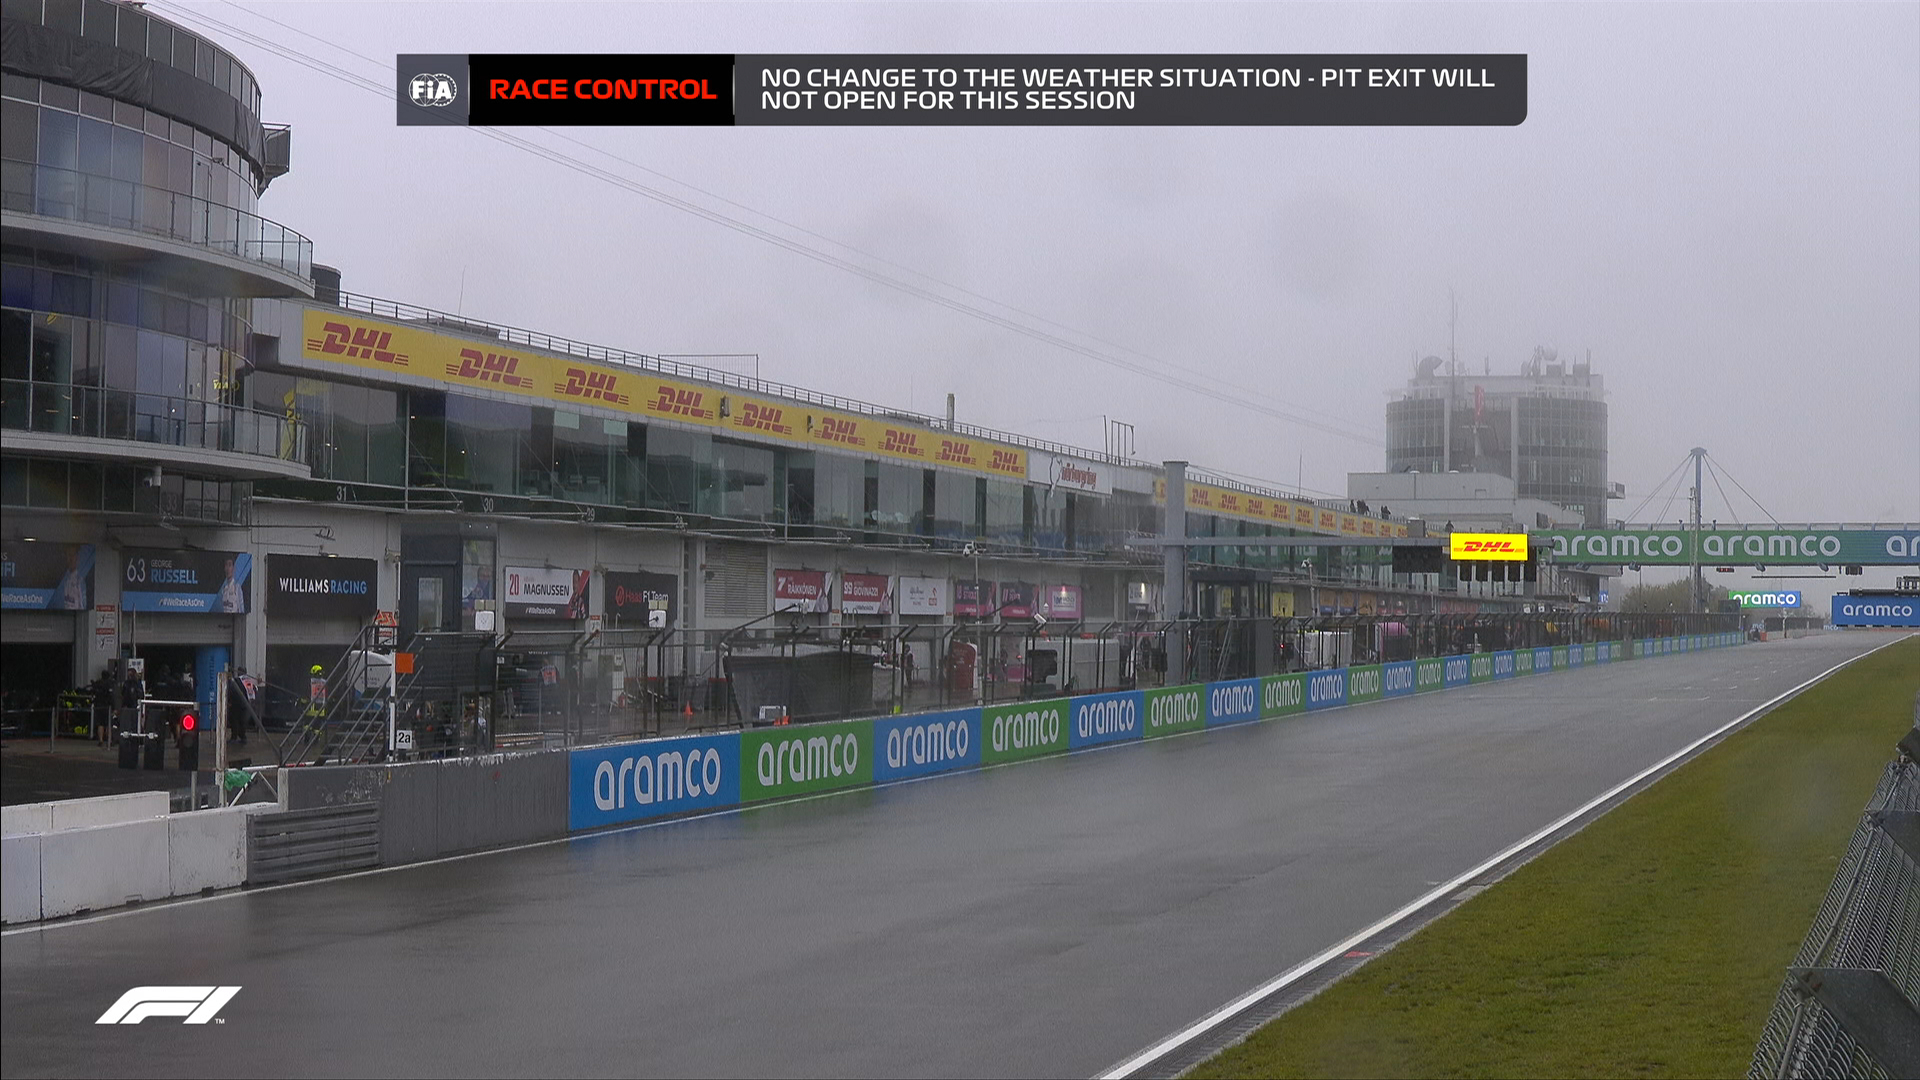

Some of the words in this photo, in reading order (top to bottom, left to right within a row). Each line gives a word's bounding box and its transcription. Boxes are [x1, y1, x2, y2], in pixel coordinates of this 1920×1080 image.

[321, 322, 397, 363] DHL
[457, 348, 522, 387] DHL
[563, 368, 620, 402] DHL
[656, 385, 707, 419] DHL
[743, 402, 786, 433] DHL
[821, 417, 860, 445] DHL
[884, 428, 919, 455] DHL
[940, 440, 971, 464] DHL
[992, 449, 1020, 473] DHL
[336, 485, 348, 502] 31
[484, 497, 494, 513] 30
[1463, 541, 1516, 553] DHL
[1552, 535, 1683, 557] aramco
[1703, 535, 1842, 557] aramco
[126, 557, 146, 583] 63
[150, 558, 173, 569] GEORGE
[150, 568, 198, 585] RUSSELL
[279, 577, 329, 594] WILLIAMS
[330, 579, 368, 595] RACING
[509, 573, 520, 596] 20
[777, 576, 787, 592] 7
[843, 582, 853, 595] 99
[523, 583, 570, 597] MAGNUSSEN
[651, 590, 669, 602] Team
[1732, 593, 1797, 605] aramco
[1842, 604, 1913, 617] aramco
[1386, 665, 1413, 691] aramco
[1417, 662, 1442, 685] aramco
[1446, 659, 1468, 682] aramco
[1471, 656, 1491, 678] aramco
[1264, 678, 1302, 710] aramco
[1310, 673, 1344, 703] aramco
[1350, 669, 1380, 696] aramco
[1150, 689, 1199, 728] aramco
[1211, 683, 1255, 717] aramco
[1078, 697, 1136, 738] aramco
[398, 732, 411, 744] 2a
[991, 708, 1060, 753] aramco
[886, 718, 970, 769] aramco
[756, 731, 859, 787] aramco
[593, 747, 722, 812] aramco
